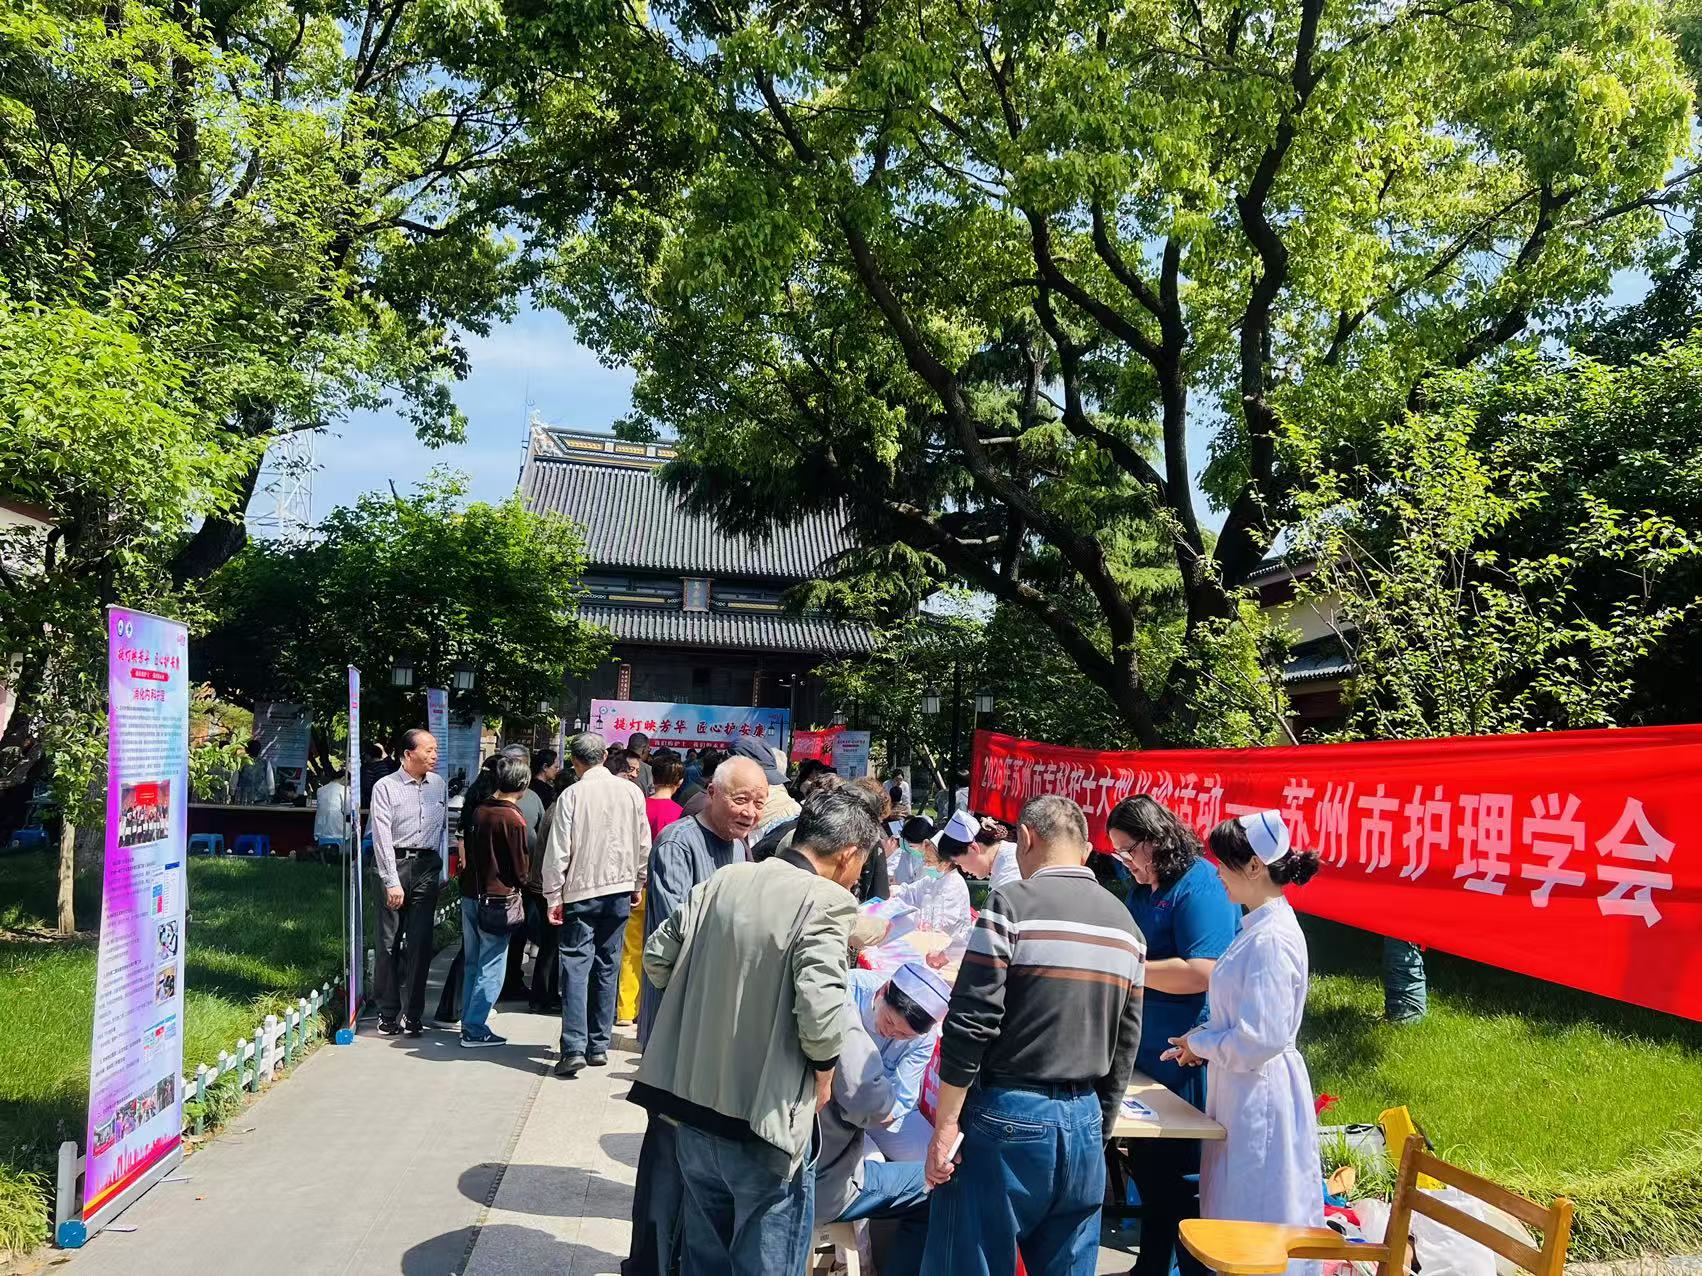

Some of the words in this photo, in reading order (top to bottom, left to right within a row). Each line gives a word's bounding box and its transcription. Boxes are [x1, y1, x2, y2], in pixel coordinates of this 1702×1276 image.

[614, 717, 688, 734] 提灯映芳华
[696, 721, 766, 737] 匠心护安康
